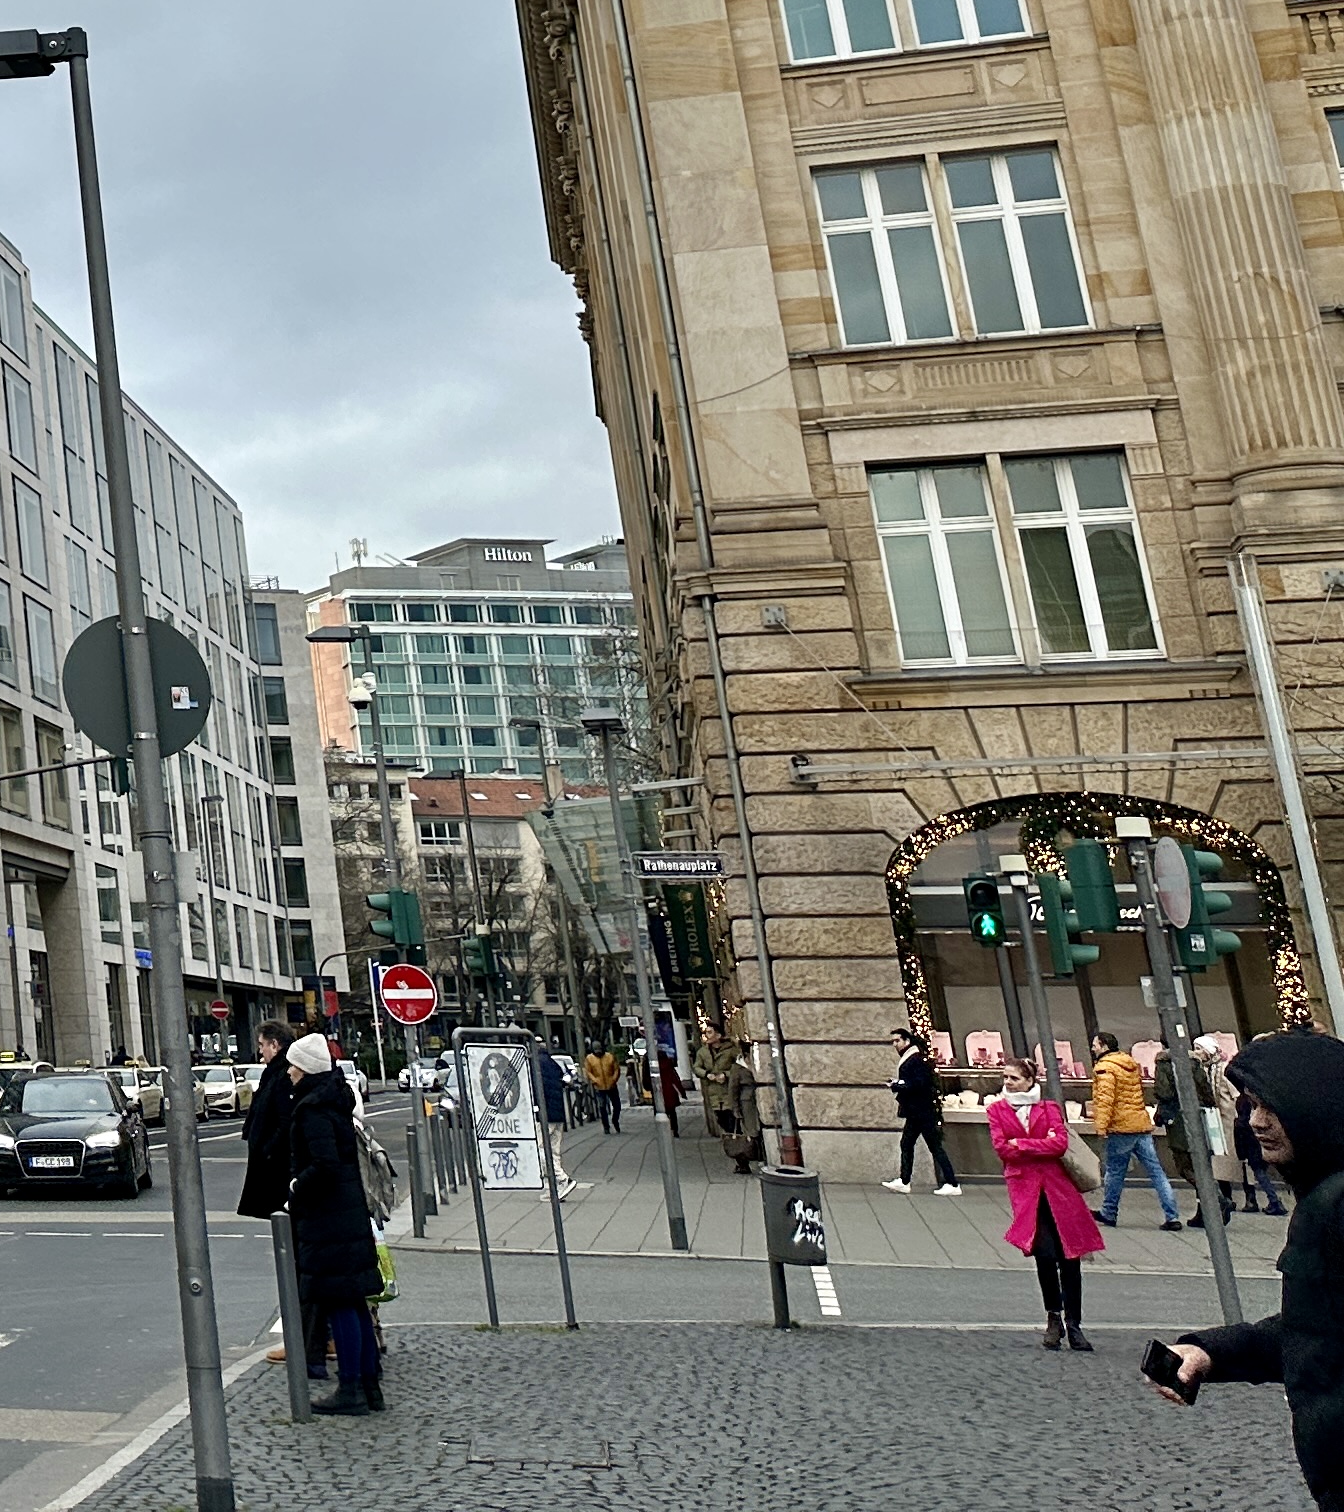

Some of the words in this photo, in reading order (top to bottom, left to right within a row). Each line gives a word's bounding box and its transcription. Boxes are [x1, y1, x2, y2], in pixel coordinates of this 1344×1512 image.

[484, 547, 532, 561] Hilton
[643, 859, 718, 873] Rathenauplatz
[683, 904, 700, 953] ROLEX
[663, 919, 680, 973] BREITLING
[490, 1118, 522, 1135] ZONE
